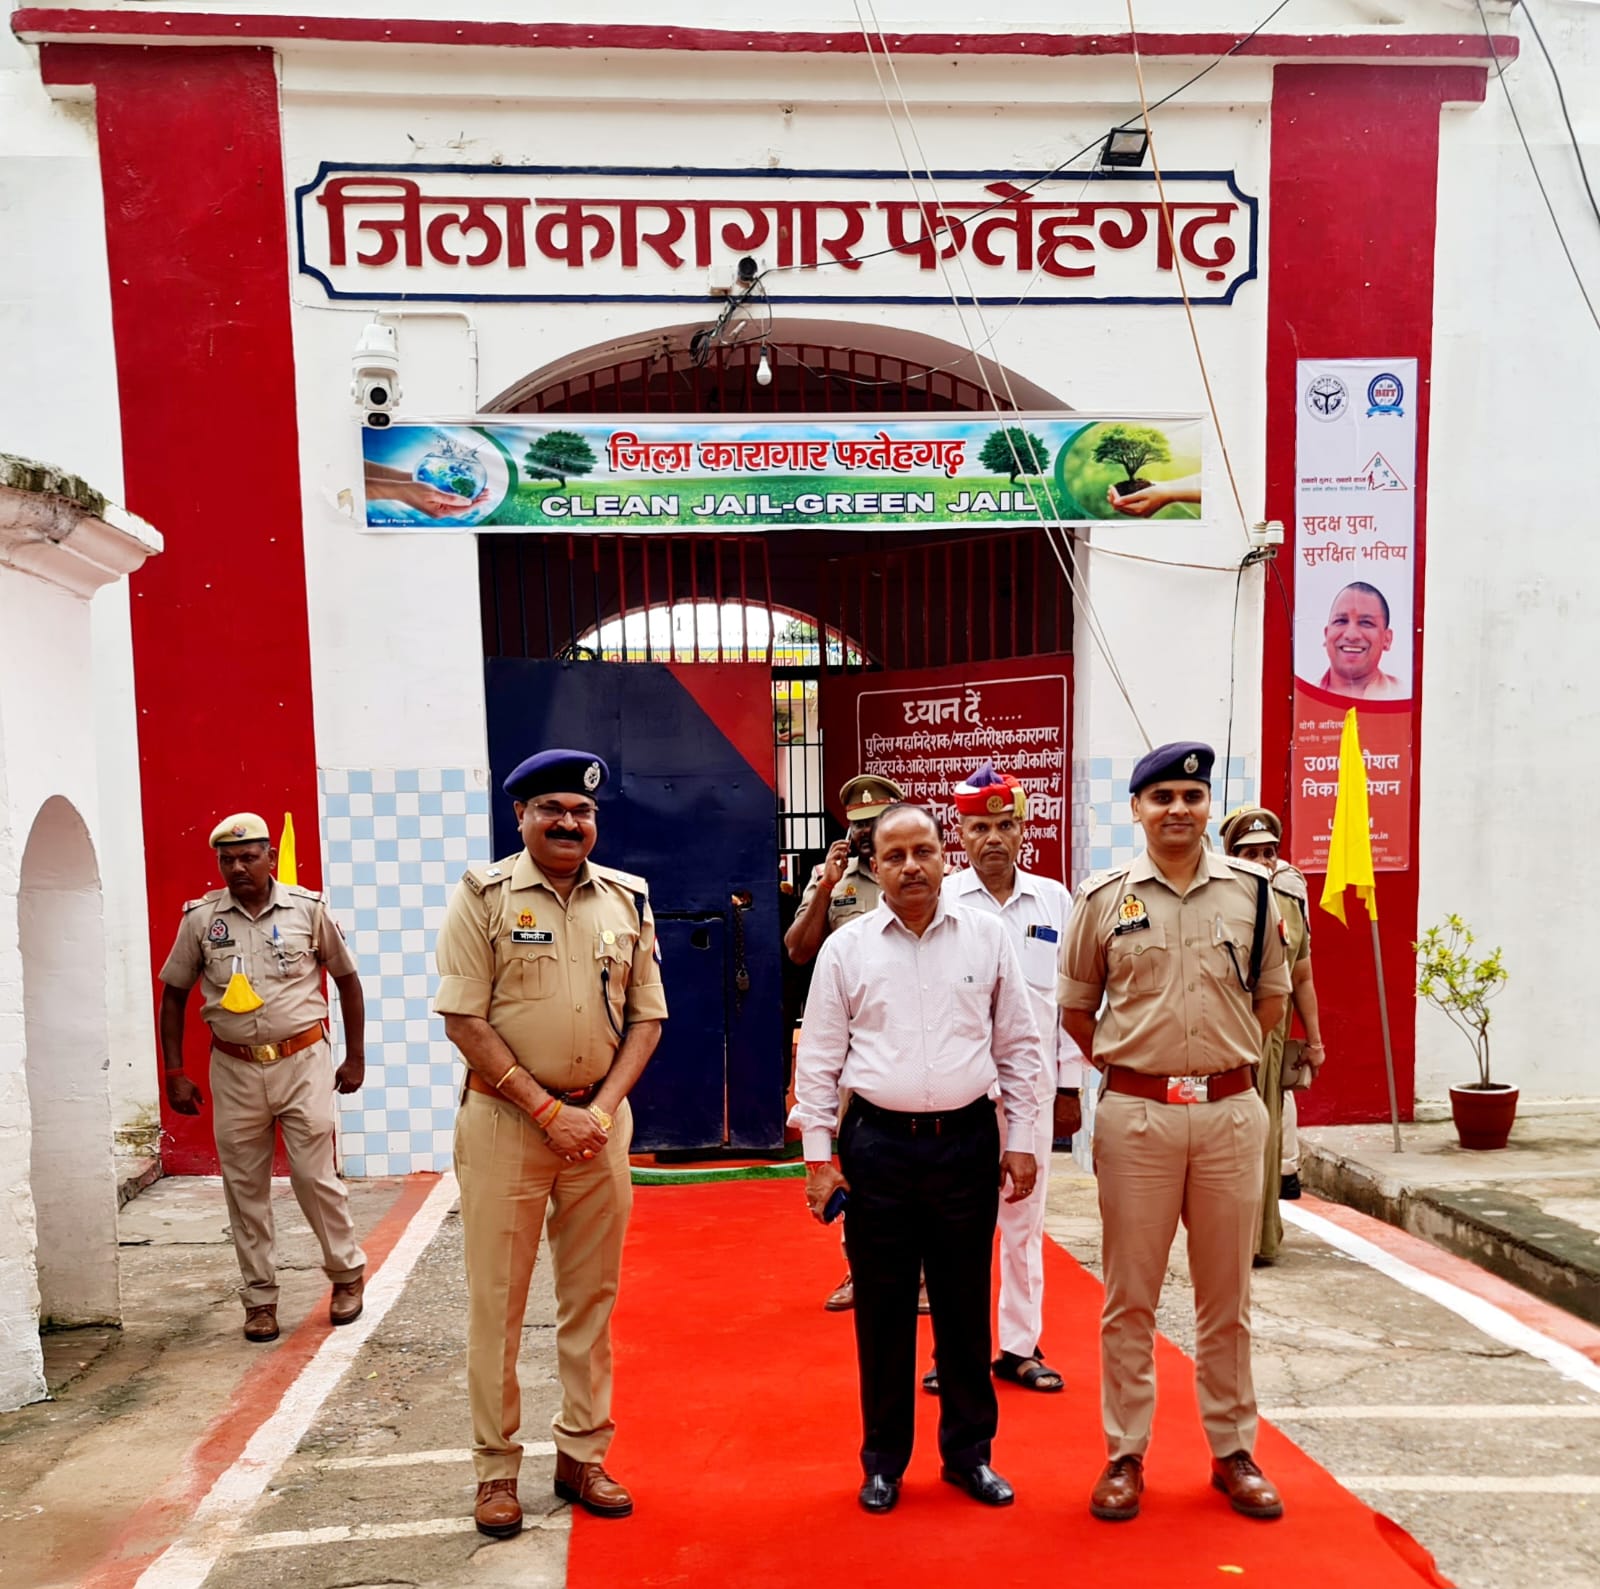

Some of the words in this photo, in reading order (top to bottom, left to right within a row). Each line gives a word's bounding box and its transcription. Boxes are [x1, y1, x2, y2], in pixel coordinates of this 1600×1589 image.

[317, 177, 531, 267] जिला
[535, 198, 870, 270] कारागार
[876, 181, 1239, 281] फतेहगढ़
[608, 431, 693, 472] जिला
[698, 440, 830, 471] कारागार
[834, 431, 967, 478] फतेहगढ़
[541, 494, 681, 518] CLEAN
[691, 492, 935, 517] JAIL-GREEN
[947, 490, 1038, 514] JAIL
[1302, 515, 1342, 536] सुदक्ष
[1346, 515, 1377, 535] युवा,
[1302, 541, 1356, 567] सुरक्षित
[1361, 541, 1408, 561] भविष्य
[865, 733, 894, 757] पुलिस
[865, 757, 895, 777] महोदय
[896, 755, 906, 774] के
[906, 755, 962, 777] आदेशानुसार
[1009, 747, 1064, 770] अधिकारियों
[1301, 777, 1340, 798] विका
